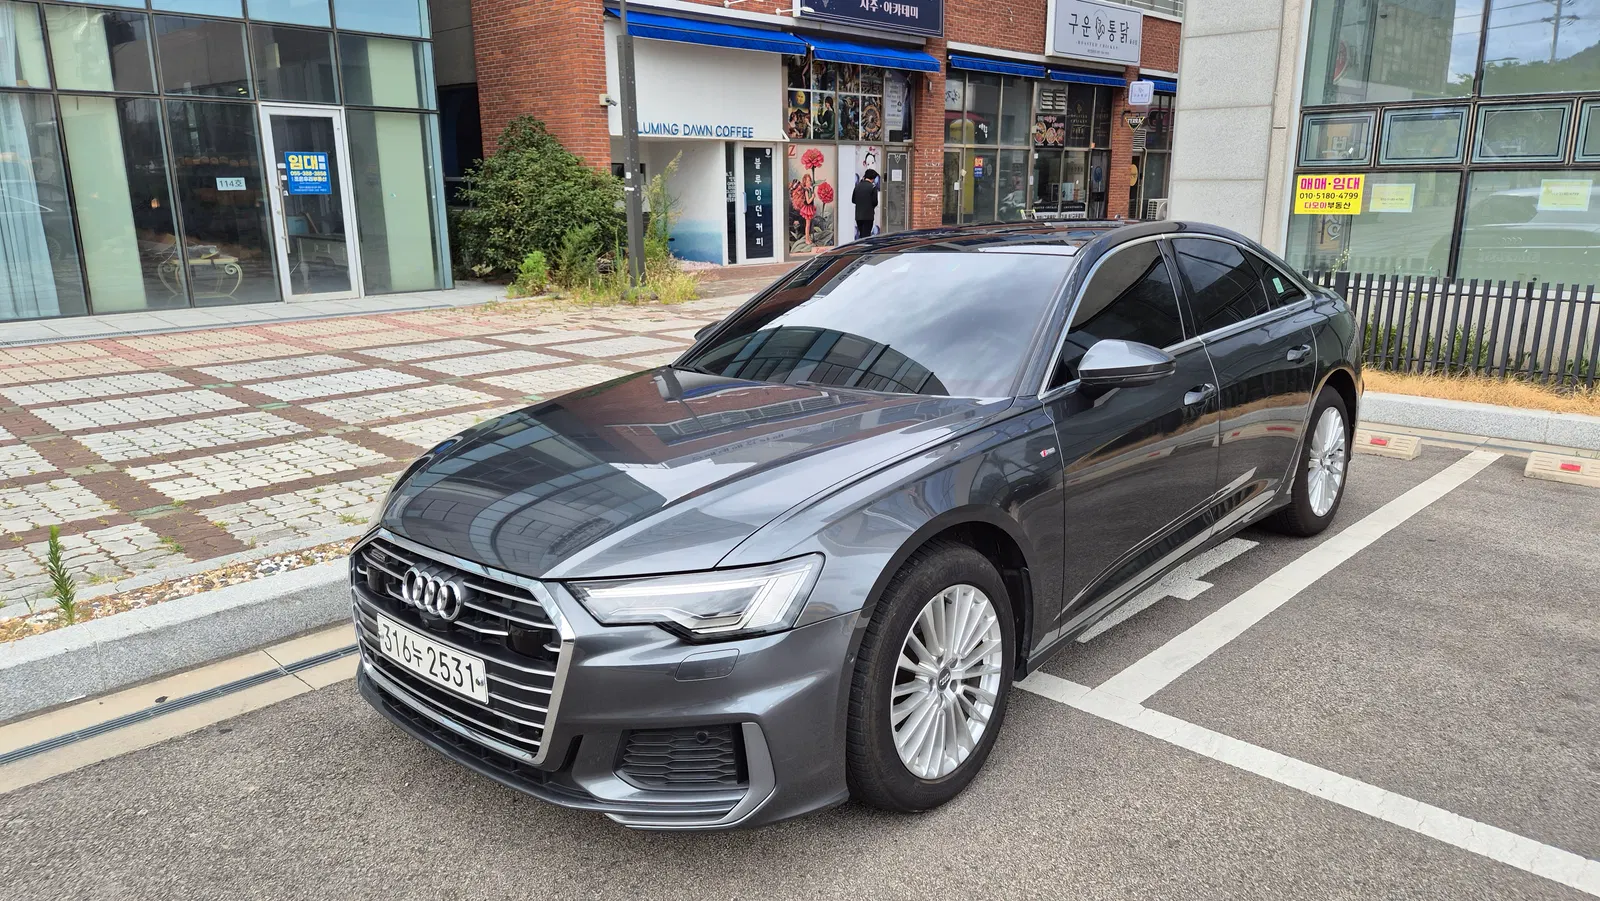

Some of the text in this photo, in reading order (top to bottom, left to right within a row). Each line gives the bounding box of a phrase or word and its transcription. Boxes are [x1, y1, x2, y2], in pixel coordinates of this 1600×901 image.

[1068, 13, 1130, 44] 구운 통닭
[683, 124, 713, 136] DAWN
[715, 125, 754, 138] COFFEE
[288, 154, 318, 170] 임대
[219, 179, 243, 188] 114호
[383, 623, 475, 693] 316누 2531
